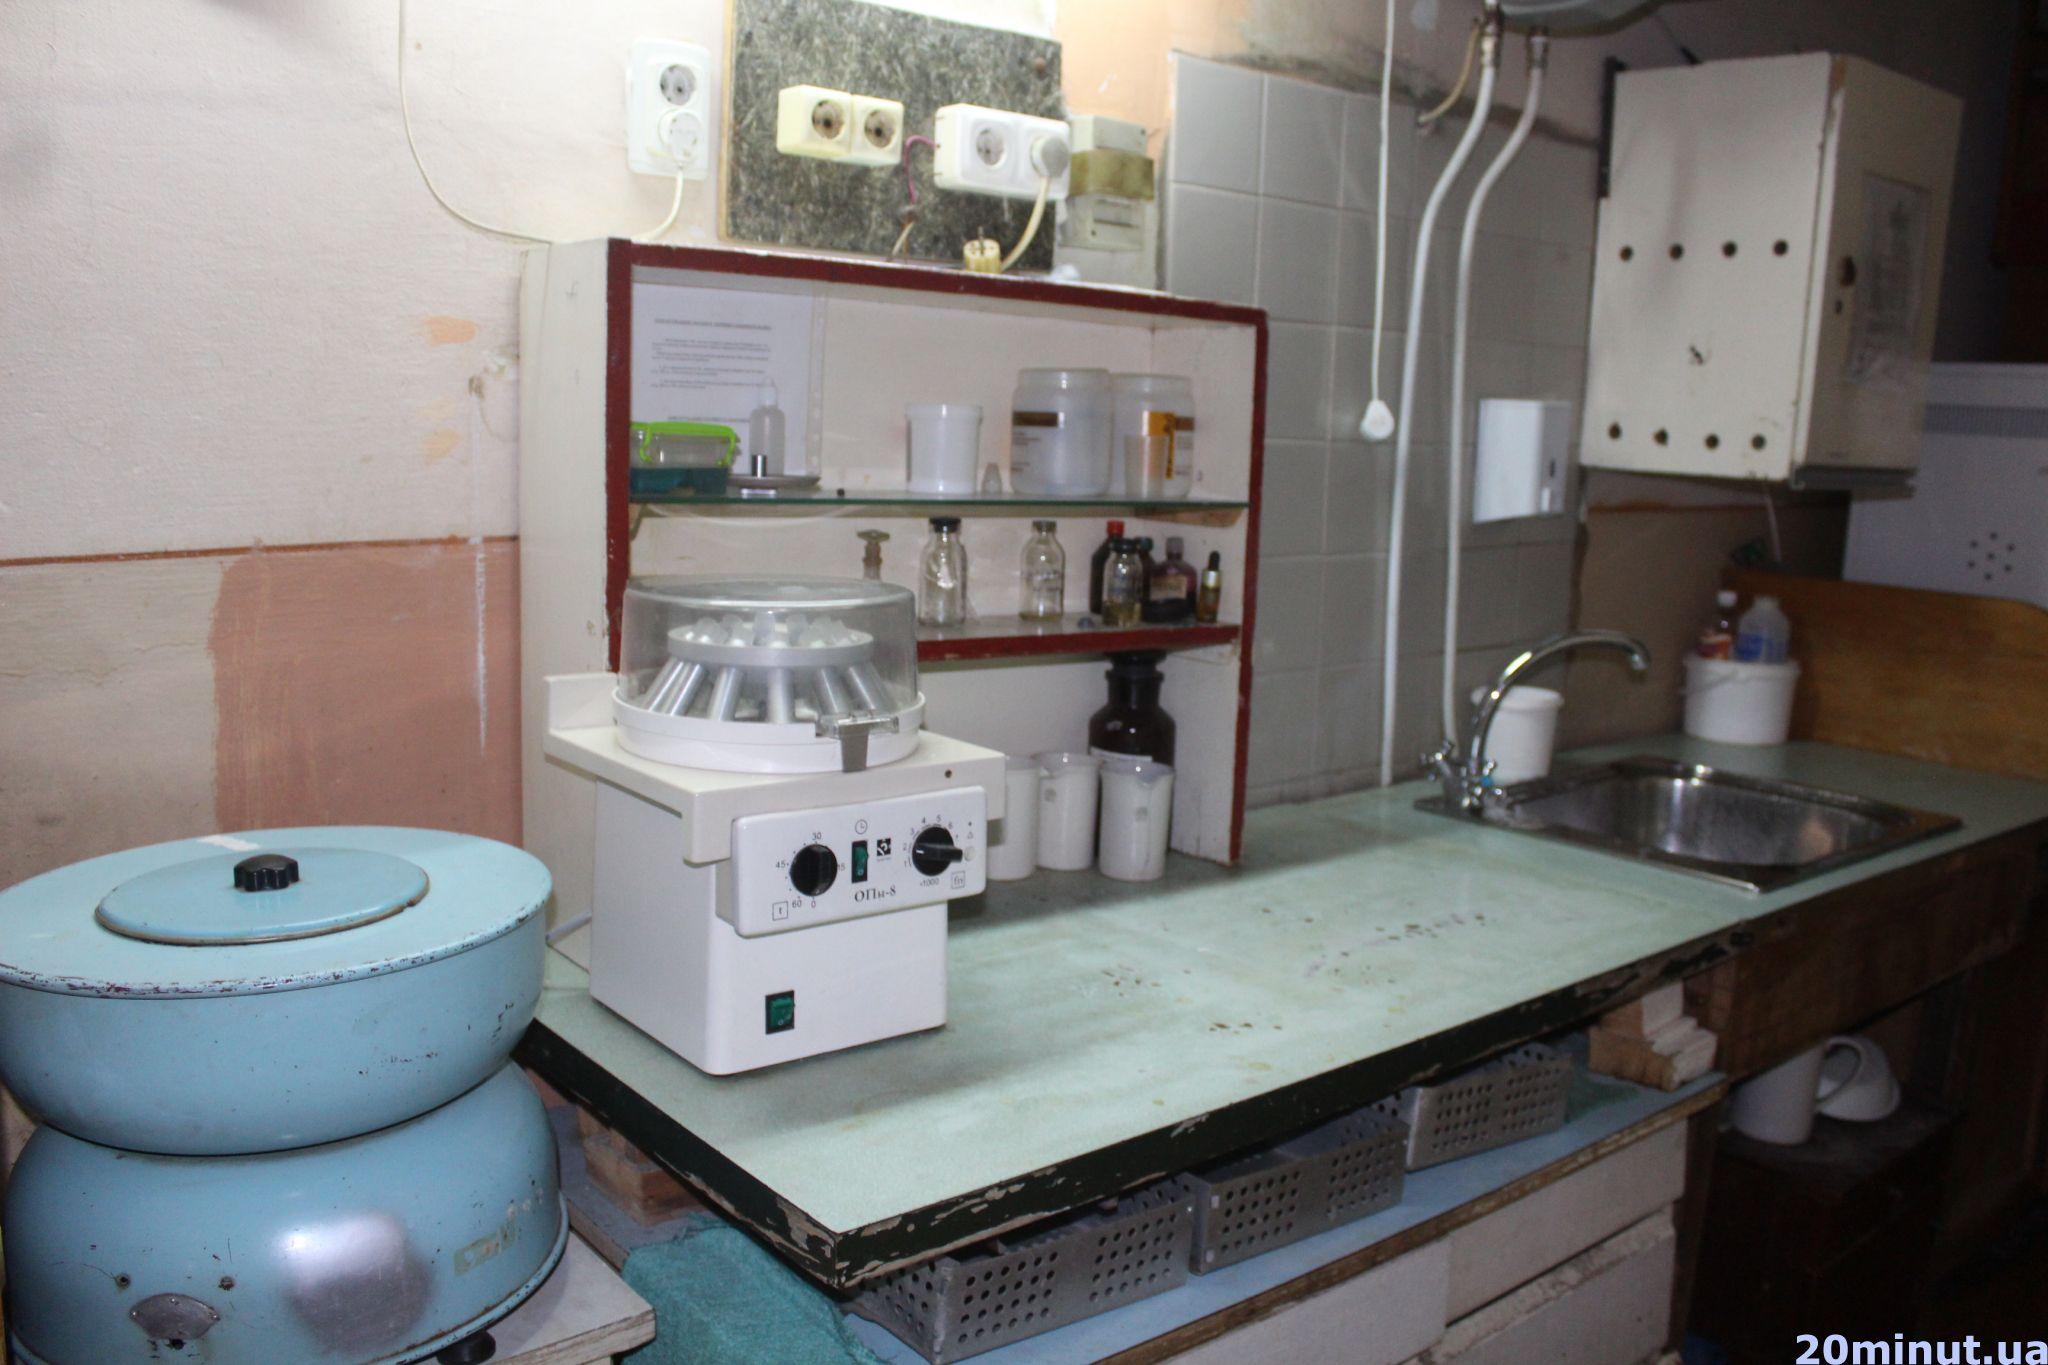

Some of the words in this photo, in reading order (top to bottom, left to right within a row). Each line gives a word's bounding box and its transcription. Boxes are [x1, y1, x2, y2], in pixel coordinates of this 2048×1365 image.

[812, 831, 822, 841] 30
[775, 860, 786, 869] 45
[791, 900, 802, 909] 60
